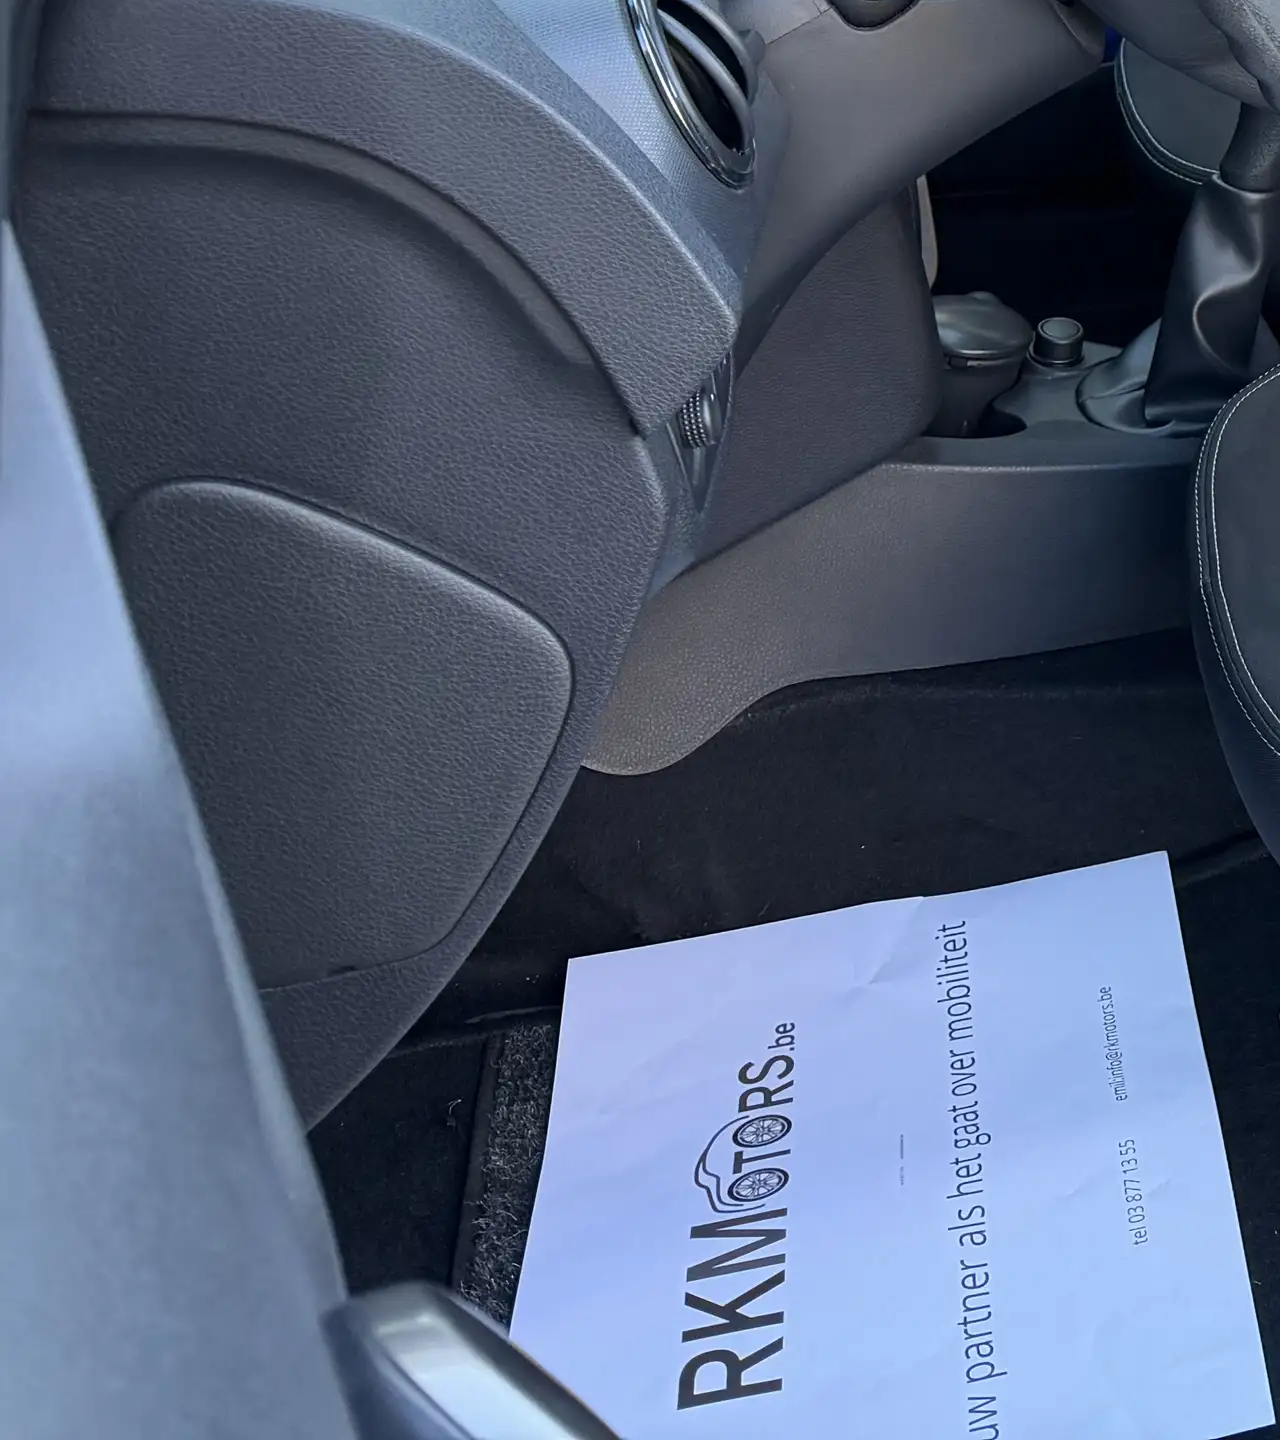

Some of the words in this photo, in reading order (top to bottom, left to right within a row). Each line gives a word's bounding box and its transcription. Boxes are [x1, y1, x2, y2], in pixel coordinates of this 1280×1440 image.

[934, 920, 974, 1041] mobiliteit
[950, 1050, 977, 1097] over
[948, 1101, 992, 1149] gaat
[1118, 1139, 1136, 1156] 55
[1120, 1158, 1139, 1174] 13
[946, 1153, 984, 1199] het
[1123, 1179, 1143, 1203] 877
[948, 1205, 987, 1246] als
[1127, 1205, 1145, 1223] 03
[1128, 1226, 1148, 1245] tel
[957, 1259, 1008, 1384] partner
